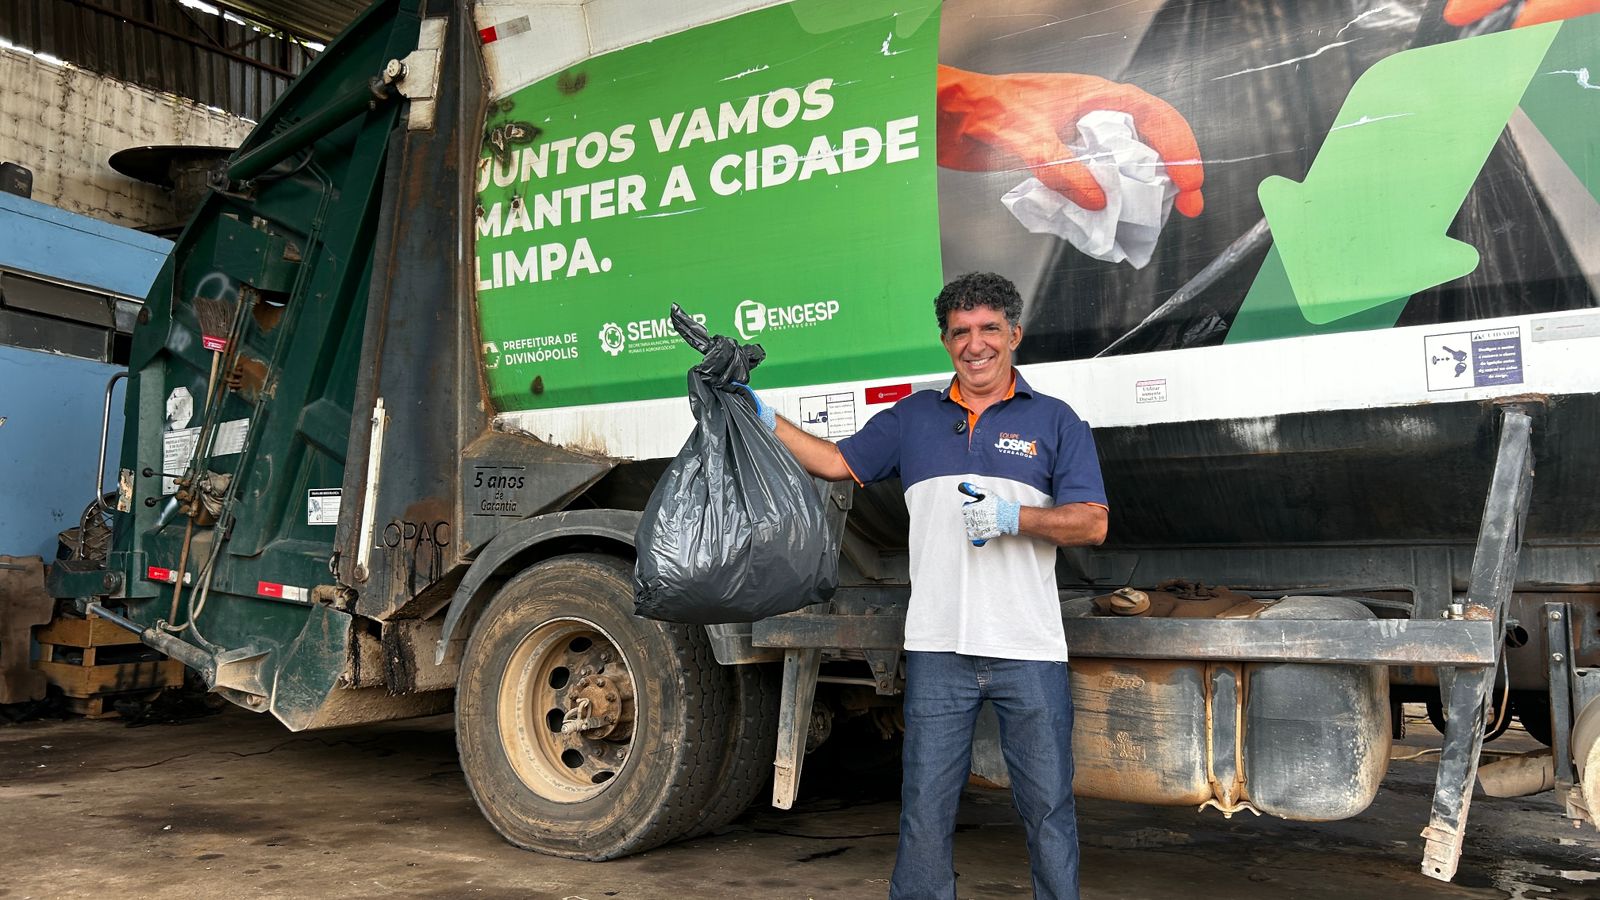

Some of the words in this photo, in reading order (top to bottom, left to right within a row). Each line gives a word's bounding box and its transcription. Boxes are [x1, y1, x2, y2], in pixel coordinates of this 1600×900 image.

[477, 124, 636, 192] JUNTOS
[649, 78, 834, 153] VAMOS
[476, 174, 647, 240] MANTER
[659, 165, 697, 208] A
[709, 115, 920, 196] CIDADE
[476, 238, 613, 291] LIMPA.
[767, 300, 839, 327] ENGESP
[502, 335, 562, 350] PREFEITURA
[564, 333, 578, 343] DE
[504, 347, 578, 366] DIVINÓPOLIS
[474, 471, 484, 488] 5
[487, 475, 525, 489] anos
[495, 490, 503, 500] de
[481, 499, 517, 511] Garantia
